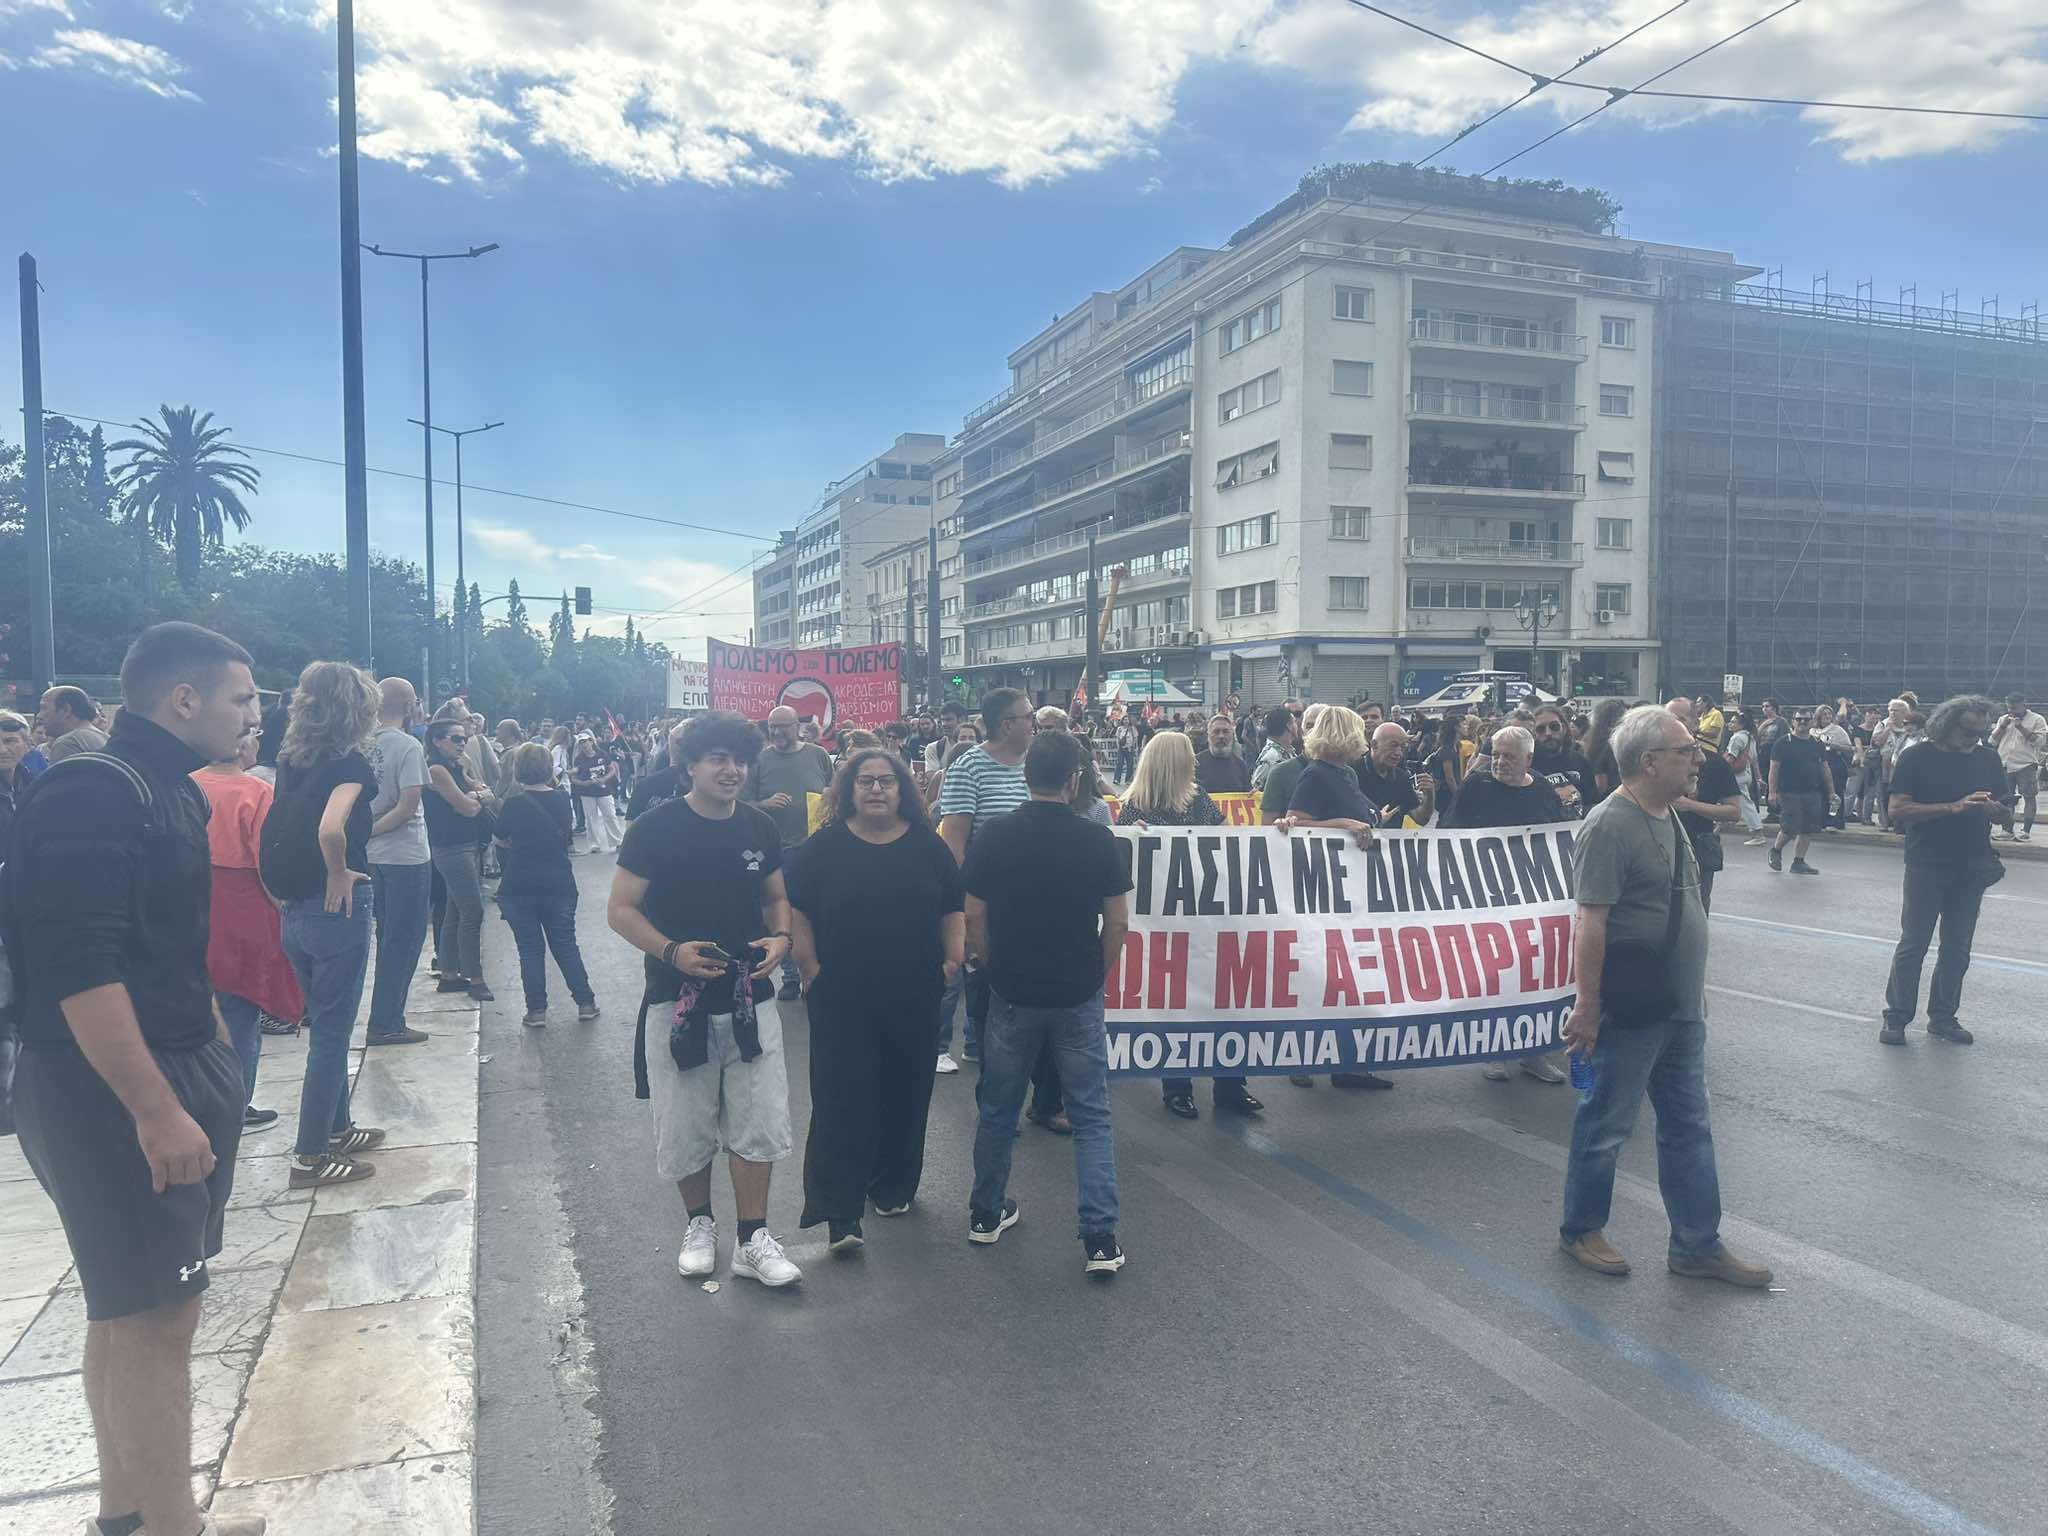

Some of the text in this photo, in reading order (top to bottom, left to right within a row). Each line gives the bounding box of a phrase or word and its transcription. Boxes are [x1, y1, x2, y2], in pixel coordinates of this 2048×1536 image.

[711, 646, 797, 675] ΠΟΛΕΜΟ
[826, 647, 899, 675] ΠΟΛΕΜΟ
[1291, 837, 1352, 914] ΜΕ
[1214, 930, 1299, 1009] ΜΕ
[1322, 914, 1576, 1008] ΑΞΙΟΠΡΕΠ
[1105, 1029, 1341, 1071] ΜΟΣΠΟΝΔΙΑ
[1352, 1011, 1553, 1064] ΥΠΑΛΛΗΛΩΝ
